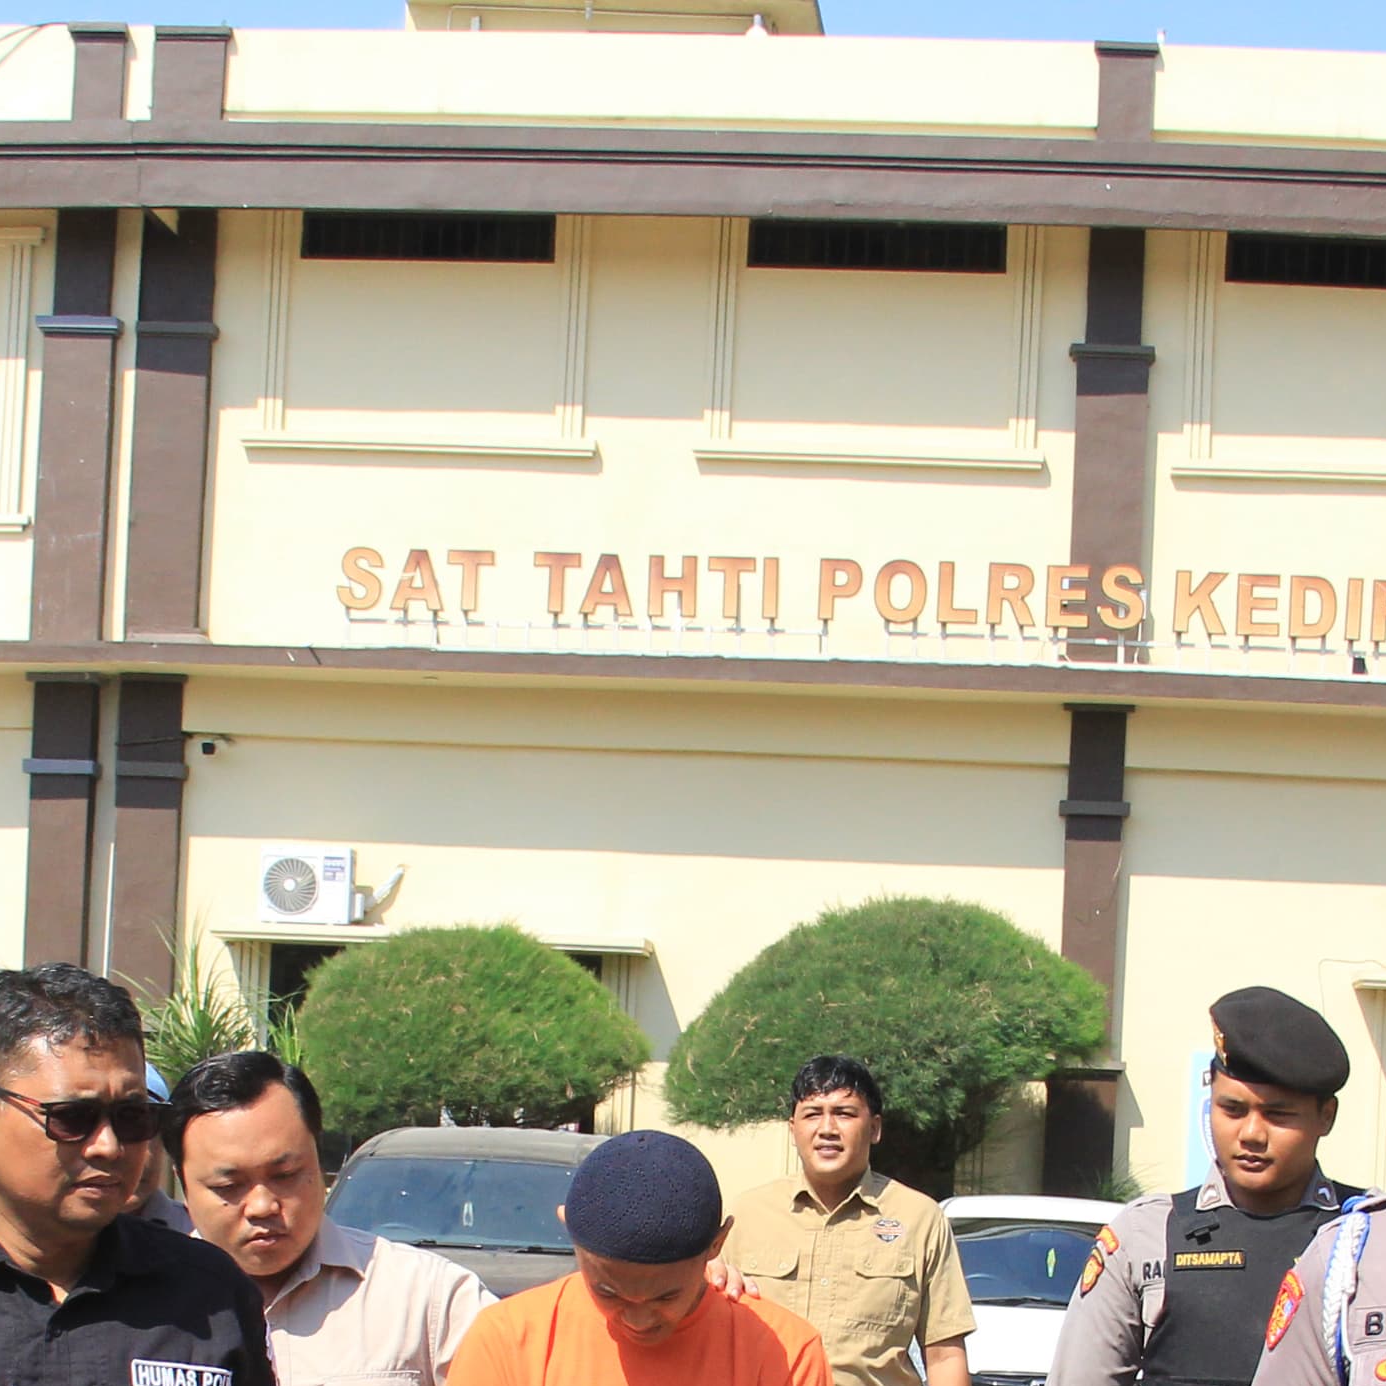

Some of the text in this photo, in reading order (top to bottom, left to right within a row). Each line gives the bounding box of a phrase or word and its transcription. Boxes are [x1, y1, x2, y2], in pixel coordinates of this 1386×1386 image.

[336, 547, 495, 611] SAT
[534, 552, 780, 619] TAHTI
[818, 558, 1146, 630] POLRES
[1176, 1251, 1242, 1266] DITSAMAPTA
[1142, 1261, 1165, 1280] RA
